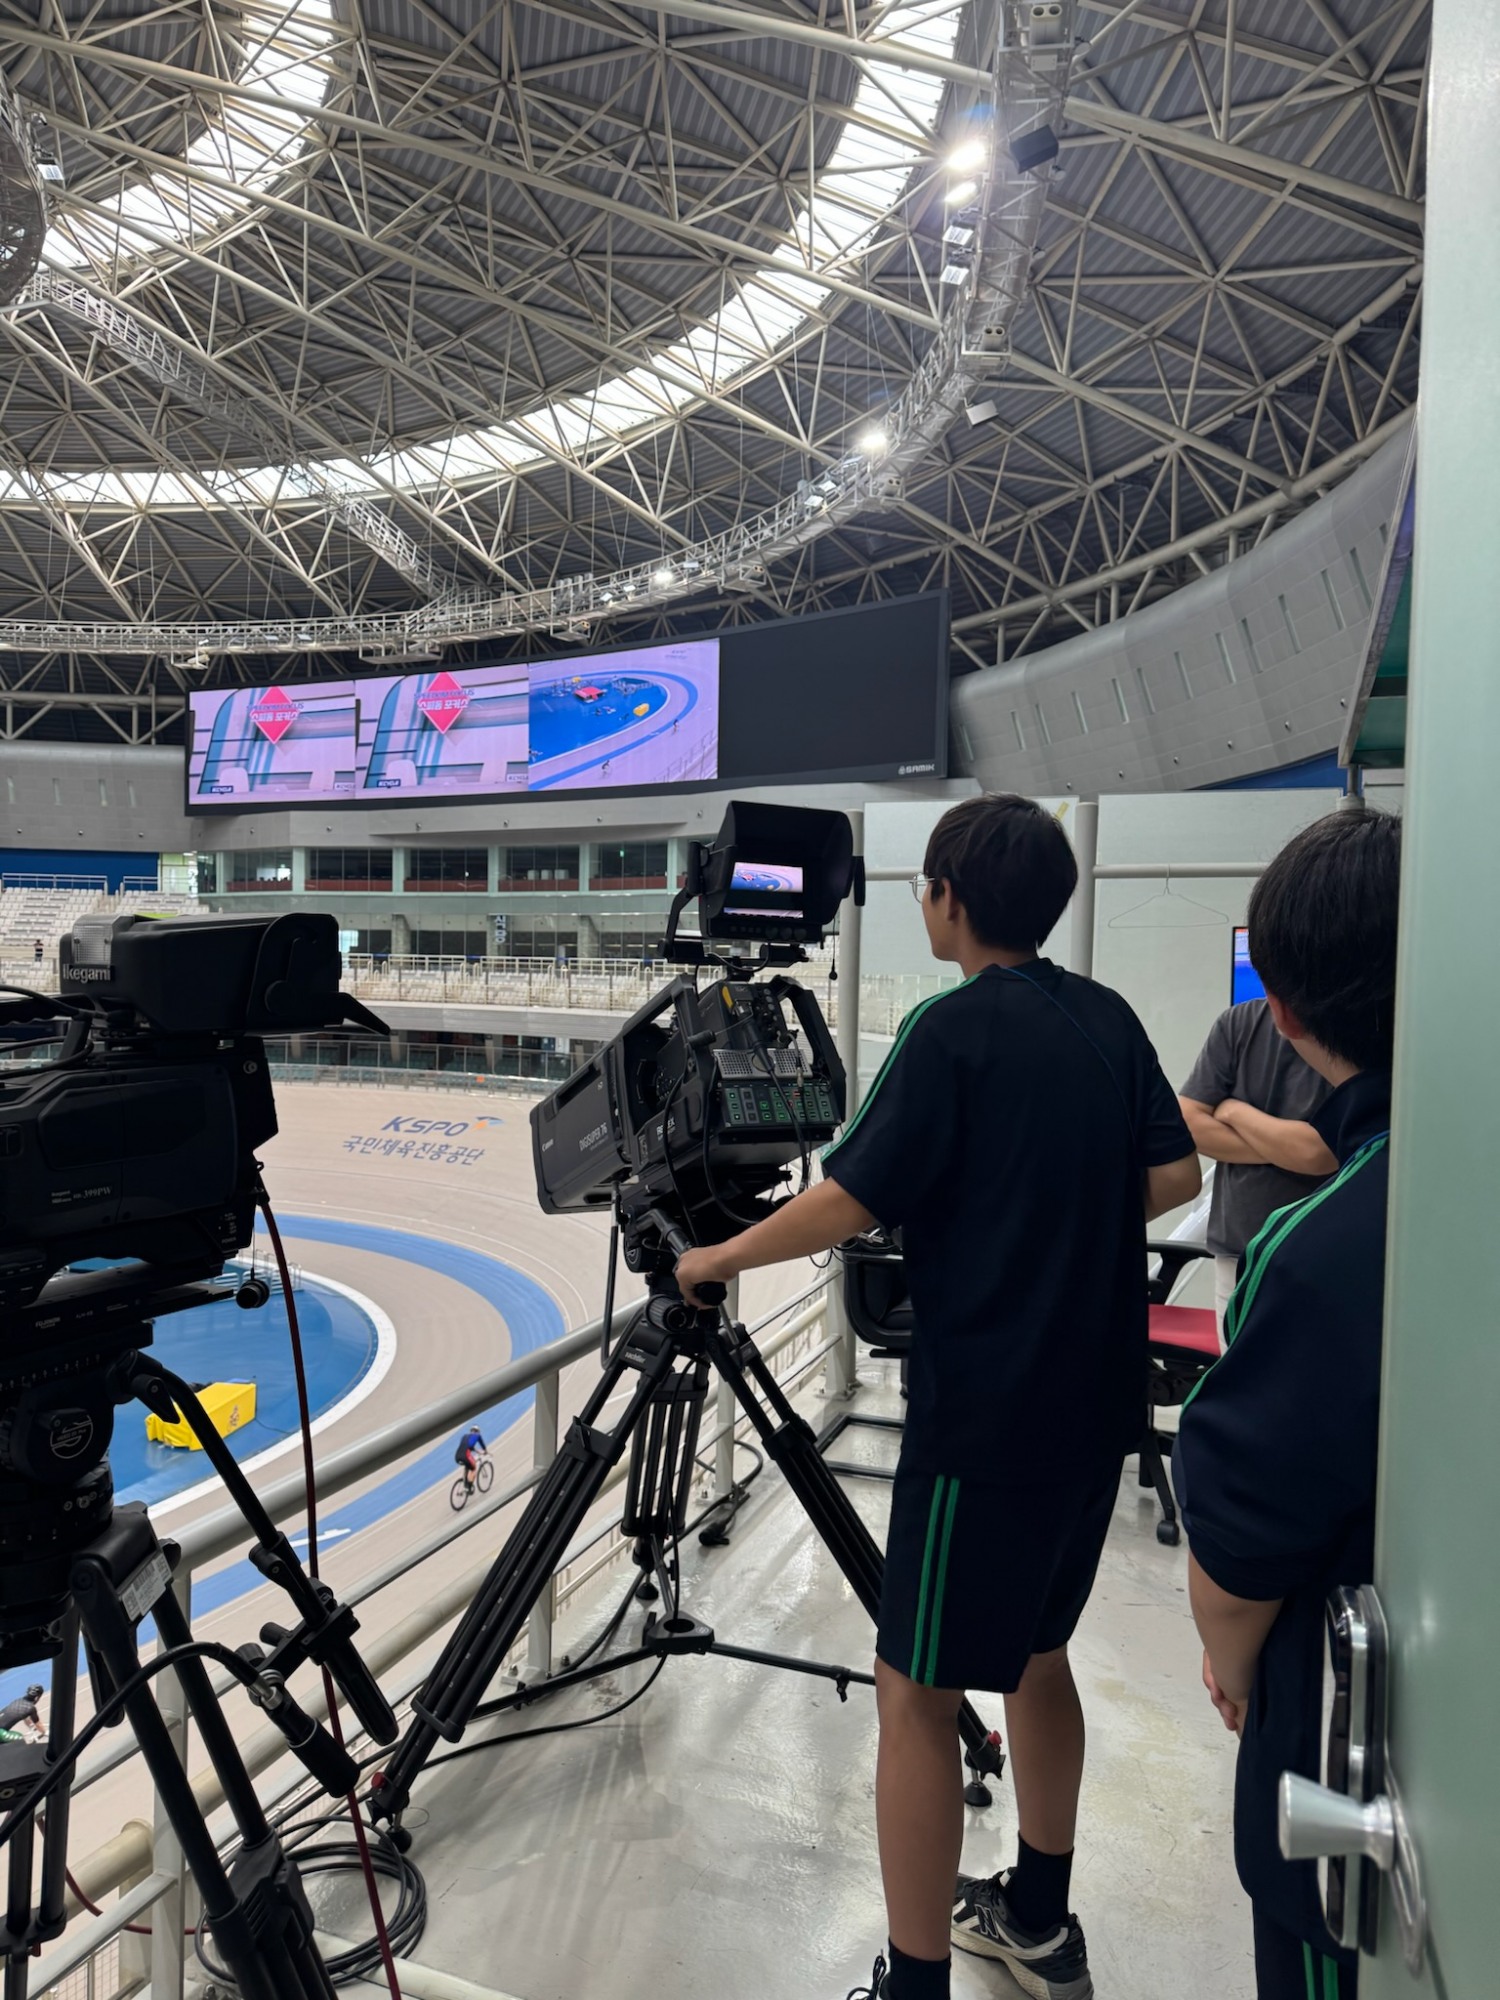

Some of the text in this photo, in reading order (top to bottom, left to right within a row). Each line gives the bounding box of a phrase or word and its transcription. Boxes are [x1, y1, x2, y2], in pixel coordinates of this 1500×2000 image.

[62, 963, 111, 984] Ikegami
[381, 1116, 469, 1137] KSPO
[342, 1135, 486, 1166] 국민체육진흥공단
